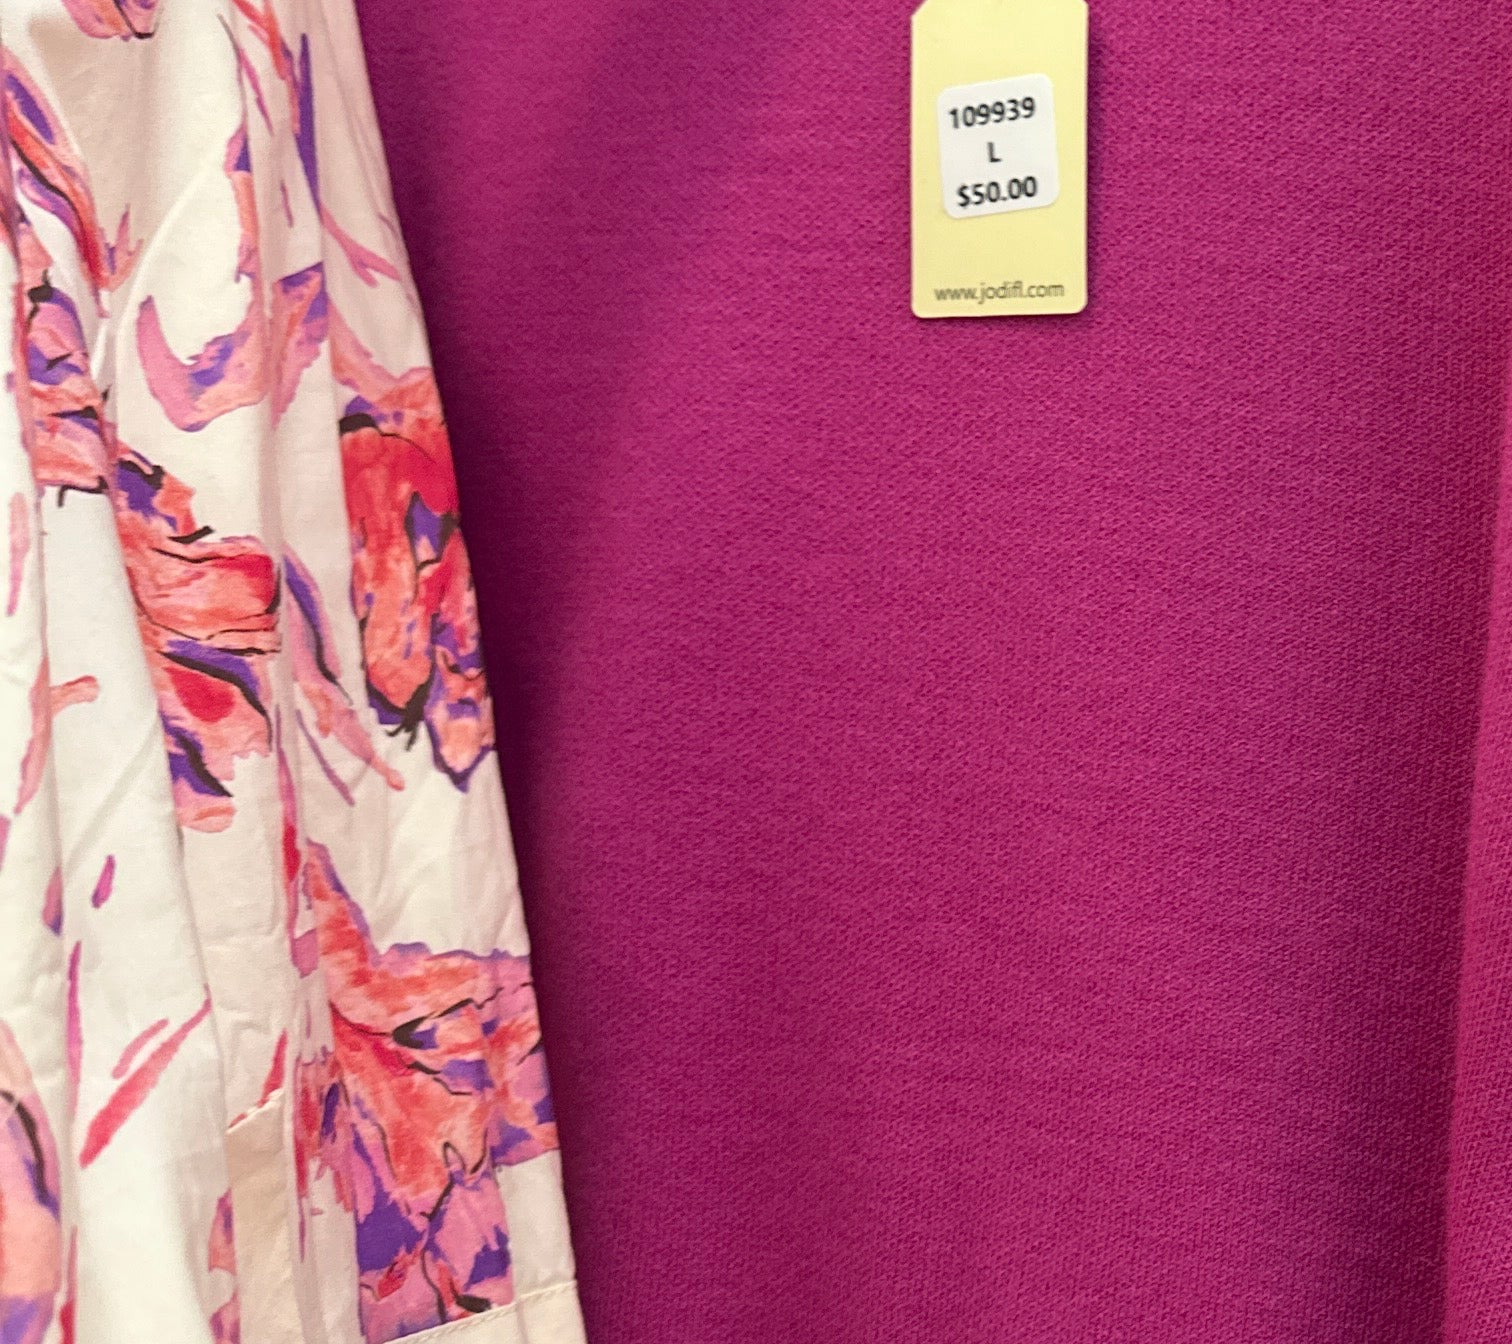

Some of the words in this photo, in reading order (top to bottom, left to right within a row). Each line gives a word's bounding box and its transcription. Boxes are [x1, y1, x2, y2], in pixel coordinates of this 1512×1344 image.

[949, 96, 1036, 129] 109939
[986, 141, 1002, 163] L
[957, 175, 1038, 208] $50.00
[934, 280, 1065, 305] www.jodifl.com
